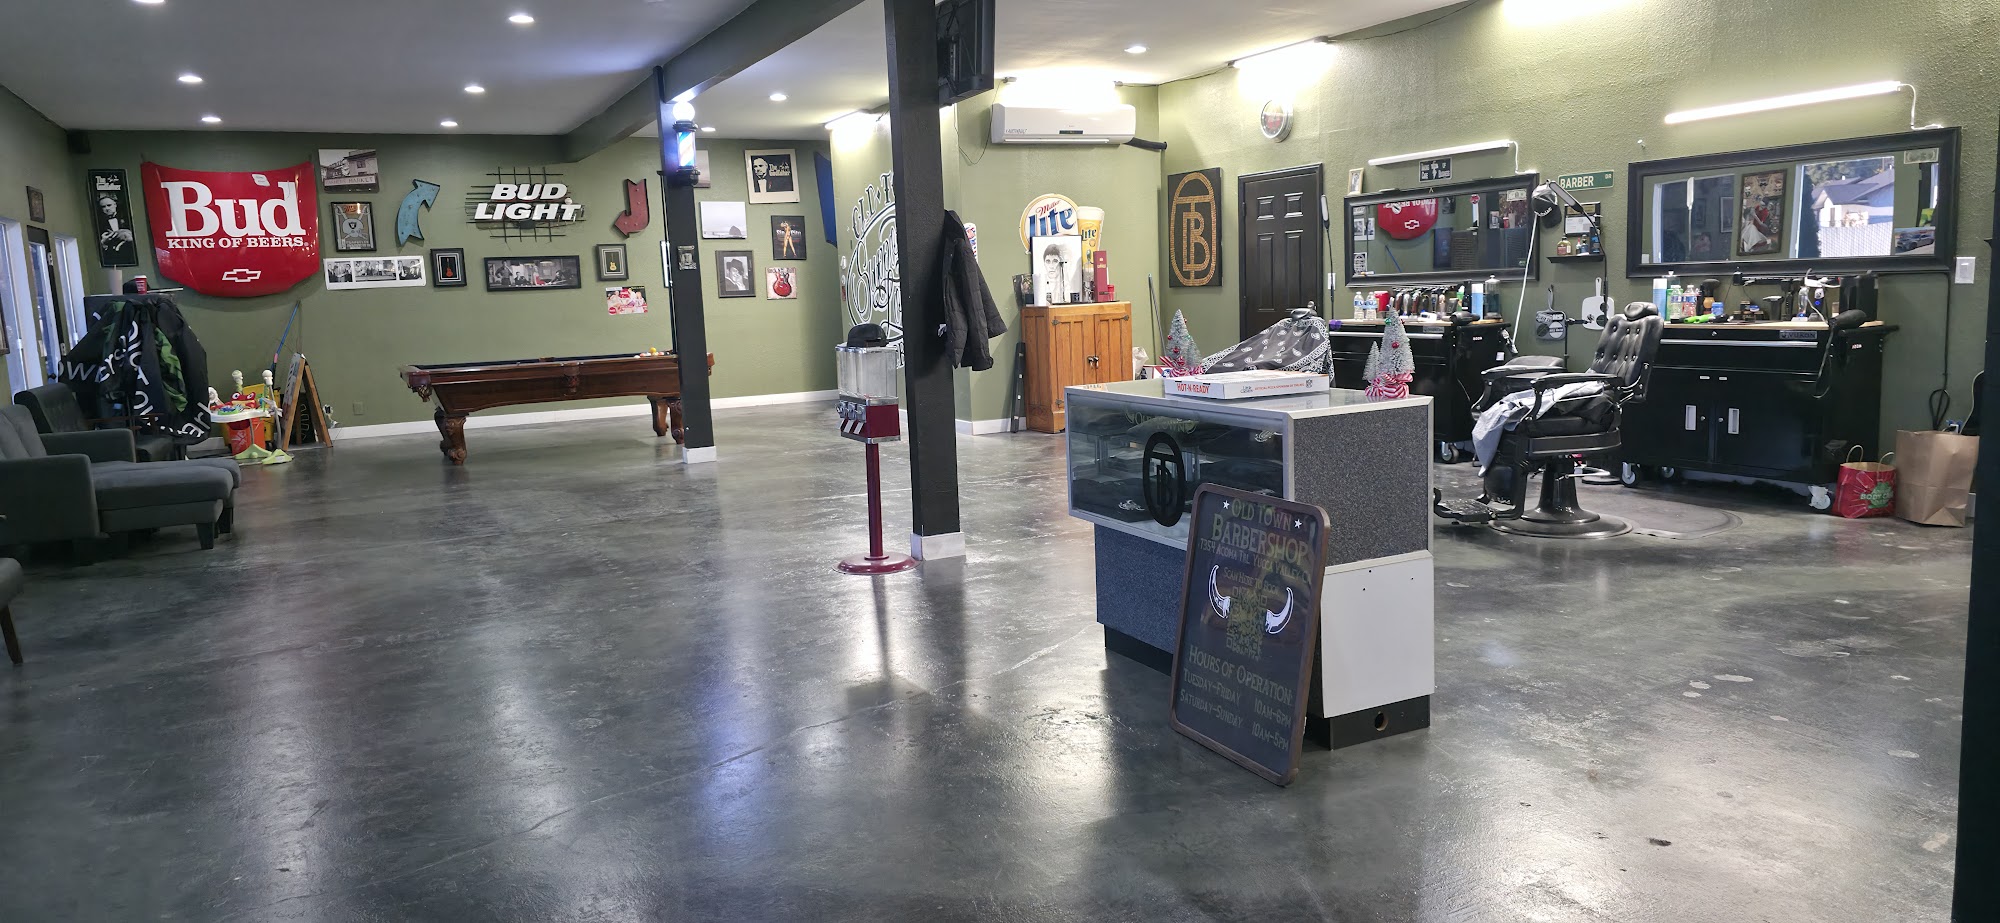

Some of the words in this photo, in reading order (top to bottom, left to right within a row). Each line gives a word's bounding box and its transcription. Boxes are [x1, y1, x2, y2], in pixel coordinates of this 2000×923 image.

[1560, 175, 1594, 188] BARBER
[490, 183, 568, 201] BUD
[161, 181, 306, 237] Bud
[474, 202, 582, 221] LIGHT
[1036, 200, 1061, 216] Miller
[166, 238, 216, 249] KING
[218, 237, 243, 248] OF
[246, 236, 304, 248] BEERS
[1176, 382, 1210, 394] HOT-N-READY
[1231, 498, 1255, 521] OLD
[1259, 504, 1292, 532] TOWN
[1211, 513, 1310, 566] BARBERSHOP
[1200, 538, 1216, 554] 7354
[1216, 543, 1238, 560] ACOMA
[1252, 555, 1274, 573] YUCCA
[1275, 560, 1302, 581] VALLEY
[1239, 571, 1255, 587] HERE
[1188, 644, 1221, 674] HOURS
[1221, 661, 1236, 679] OF
